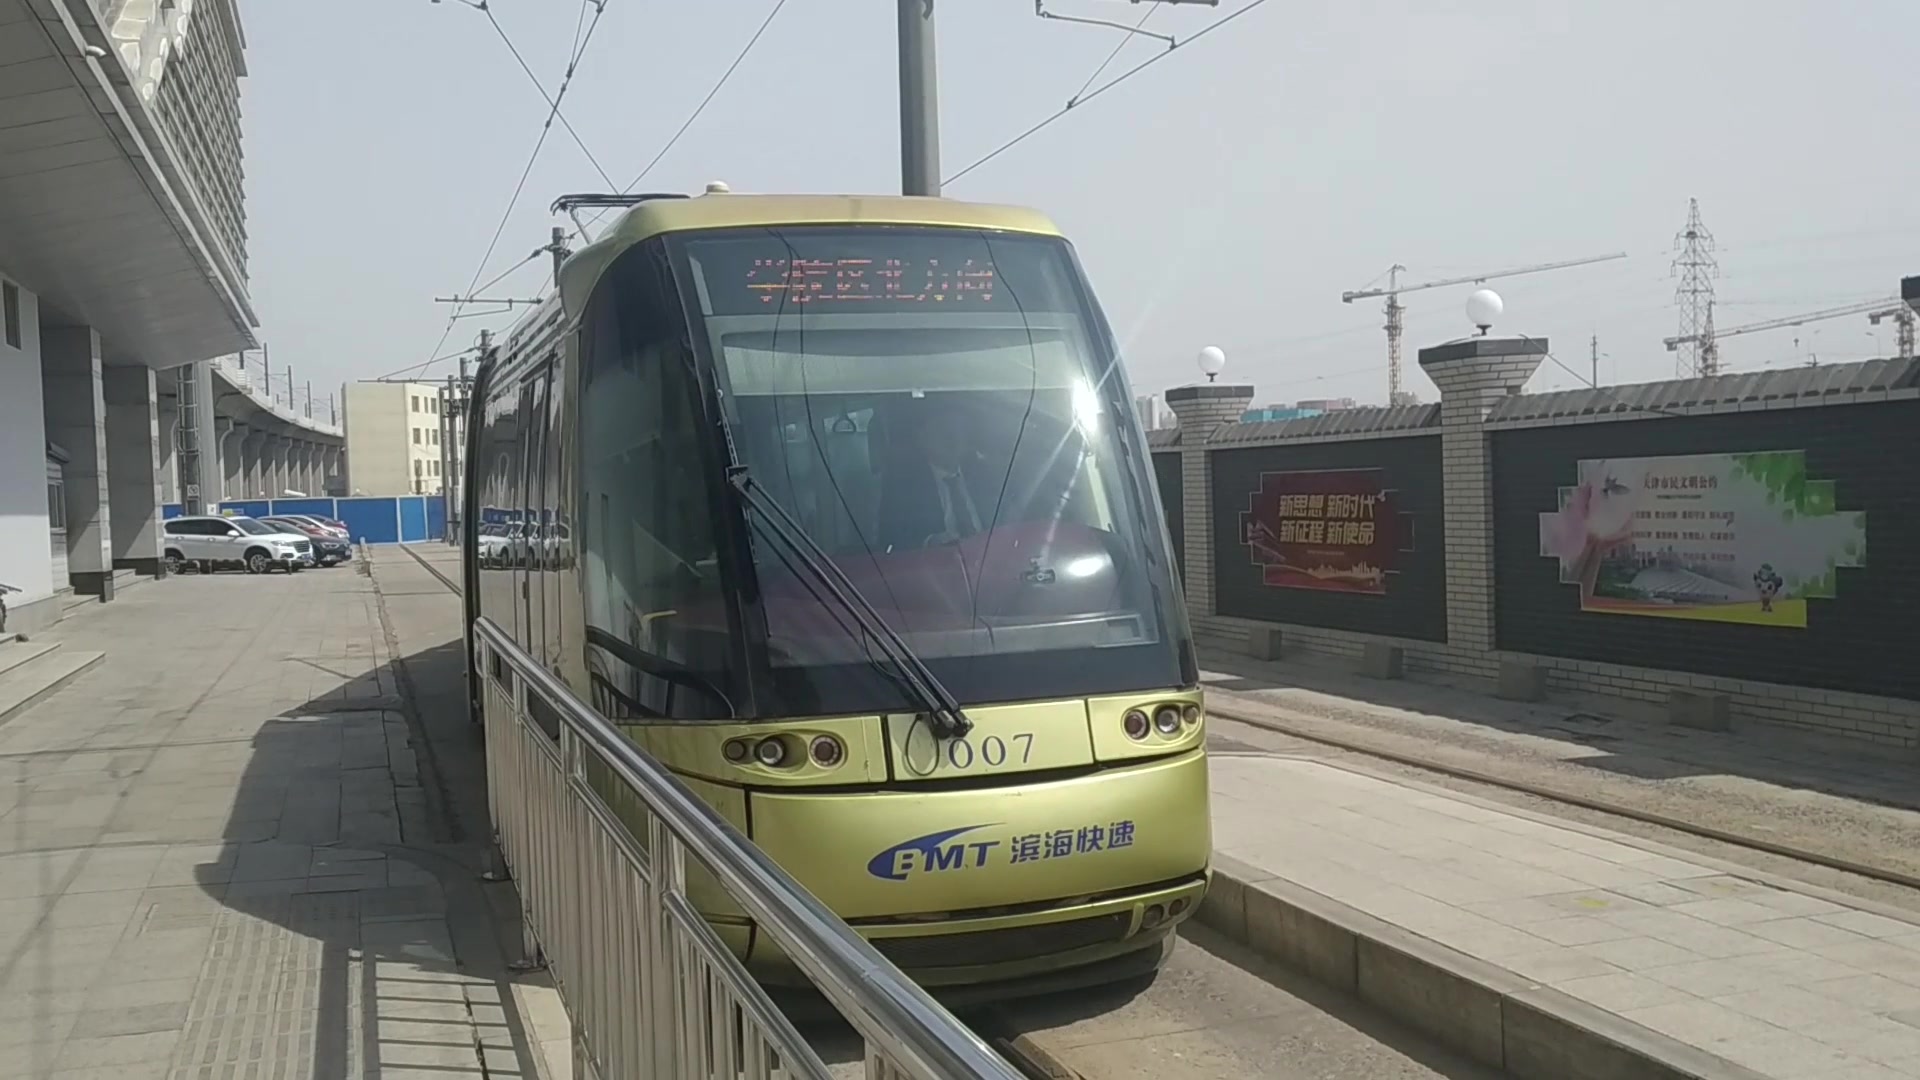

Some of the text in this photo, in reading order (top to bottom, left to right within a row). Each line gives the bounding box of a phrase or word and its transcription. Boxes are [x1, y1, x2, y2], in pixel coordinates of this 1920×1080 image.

[1279, 494, 1375, 519] 新思想 新时代
[1280, 520, 1375, 546] 新征程 新使命
[1009, 820, 1135, 864] 滨海快速
